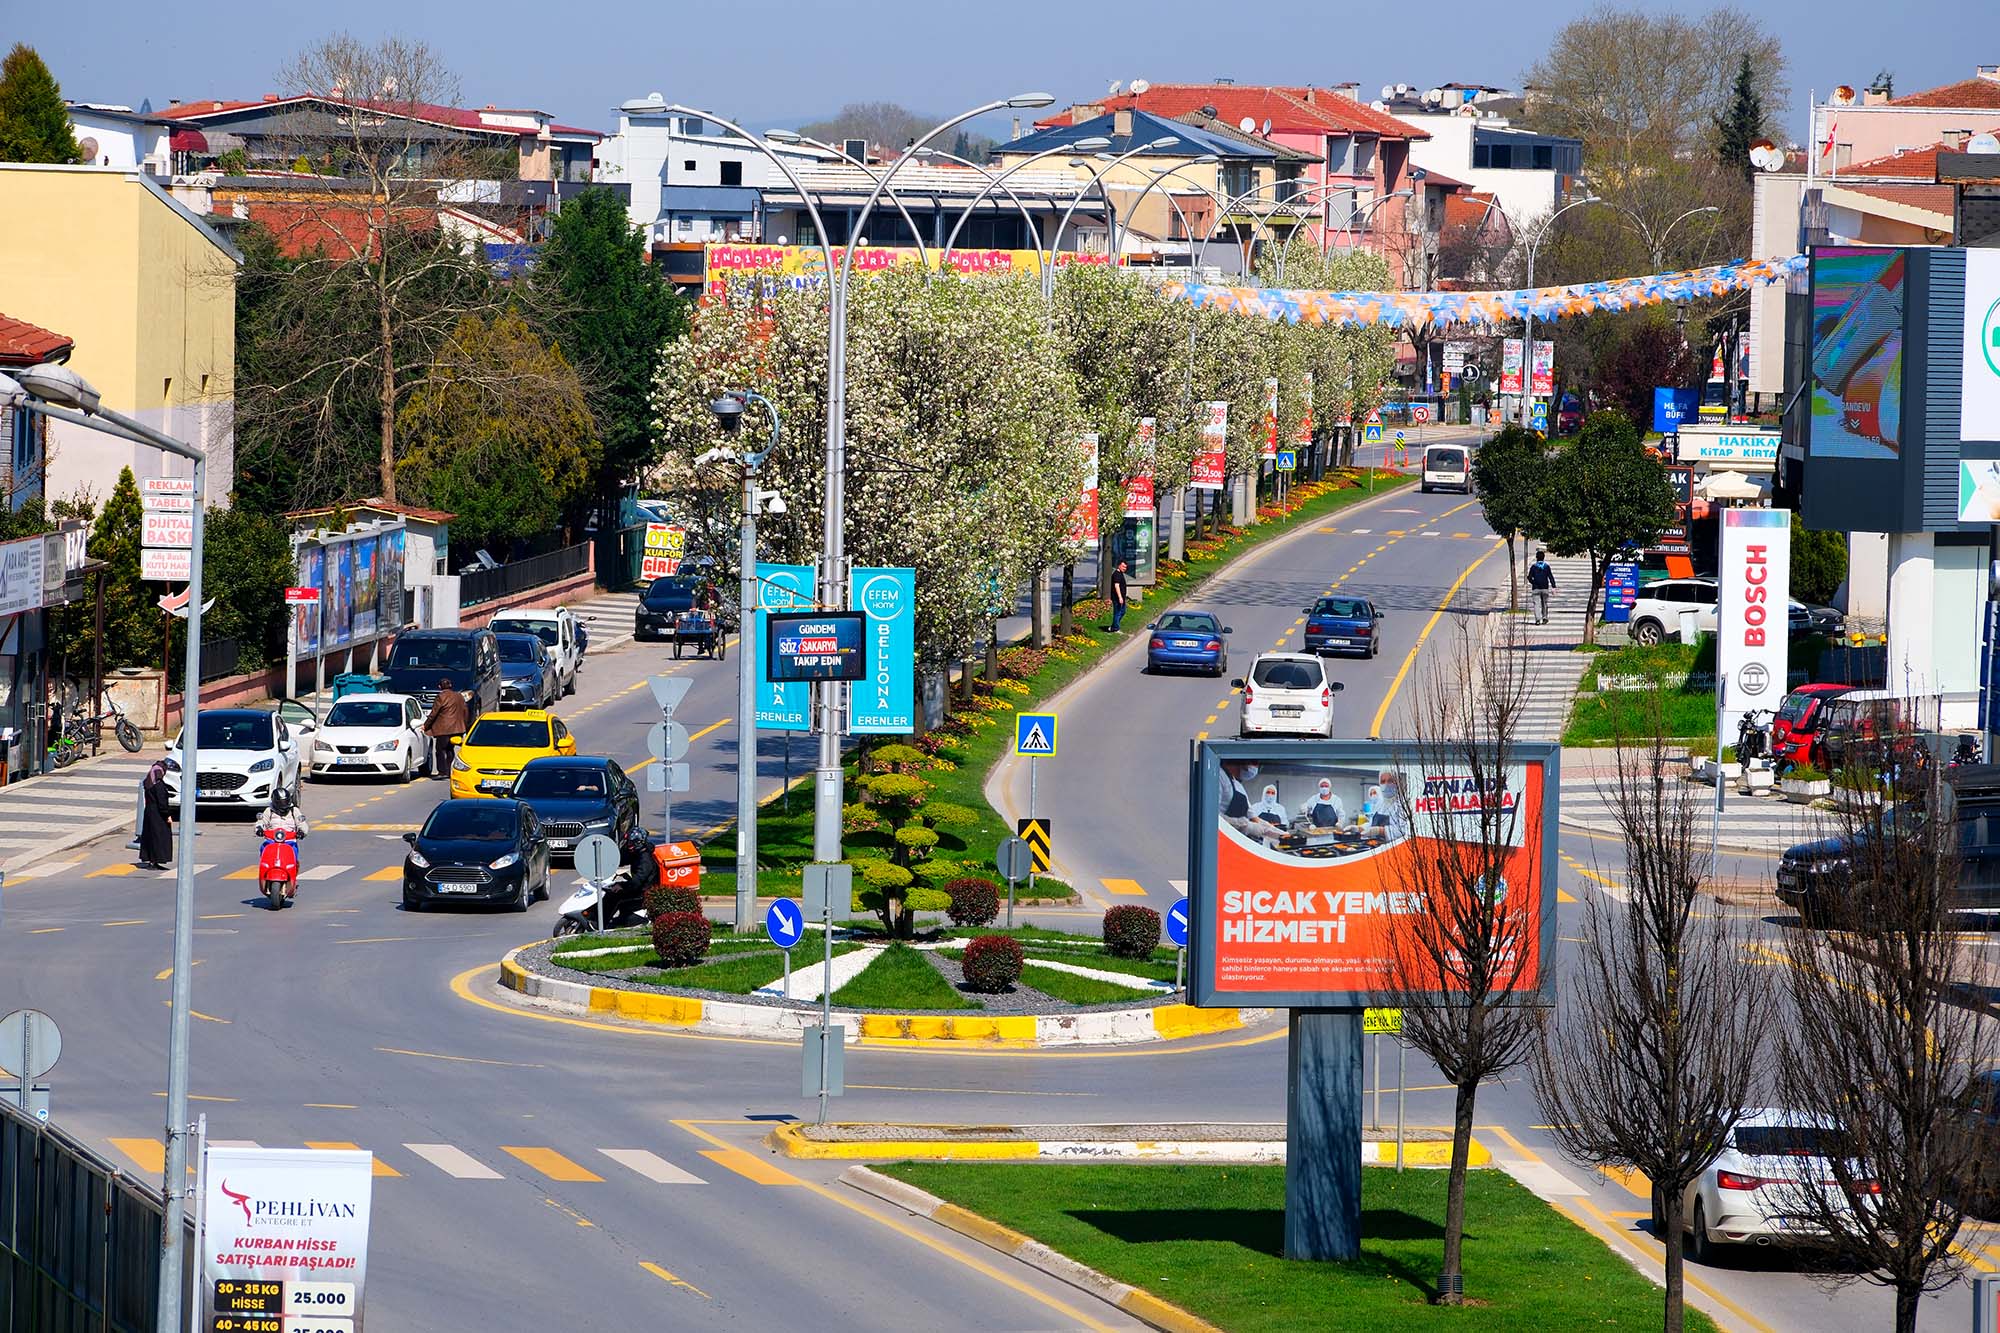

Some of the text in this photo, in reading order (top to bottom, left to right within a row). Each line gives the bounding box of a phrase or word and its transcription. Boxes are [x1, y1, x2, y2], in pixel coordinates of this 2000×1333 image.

[1700, 448, 1734, 457] KİTAP
[149, 481, 192, 490] REKLAM
[149, 498, 191, 507] TABELA
[647, 531, 684, 548] OTO
[868, 590, 899, 600] EFEM
[1744, 544, 1768, 647] BOSCH
[801, 638, 838, 653] SAKARYA
[793, 655, 842, 666] TAKİP EDİN
[857, 716, 908, 726] ERENLER
[1223, 890, 1428, 915] SICAK YEMEK
[1223, 914, 1346, 944] HİZMETİ
[1221, 956, 1253, 964] Kimsesiz
[1285, 956, 1313, 964] durumu
[1221, 965, 1243, 973] sahibi
[1244, 965, 1272, 973] binlerce
[255, 1198, 356, 1219] PEHLİVAN
[254, 1217, 313, 1227] ENTEGRE ET
[233, 1237, 337, 1251] KURBAN HİSSE
[215, 1254, 356, 1271] SATIŞLARI BAŞLADI!
[218, 1283, 232, 1294] 30
[244, 1283, 259, 1294] 35
[261, 1284, 280, 1294] KG
[231, 1296, 265, 1309] HİSSE
[293, 1291, 346, 1305] 25.000
[215, 1319, 233, 1330] 40
[243, 1320, 259, 1331] 45
[261, 1321, 279, 1331] KG
